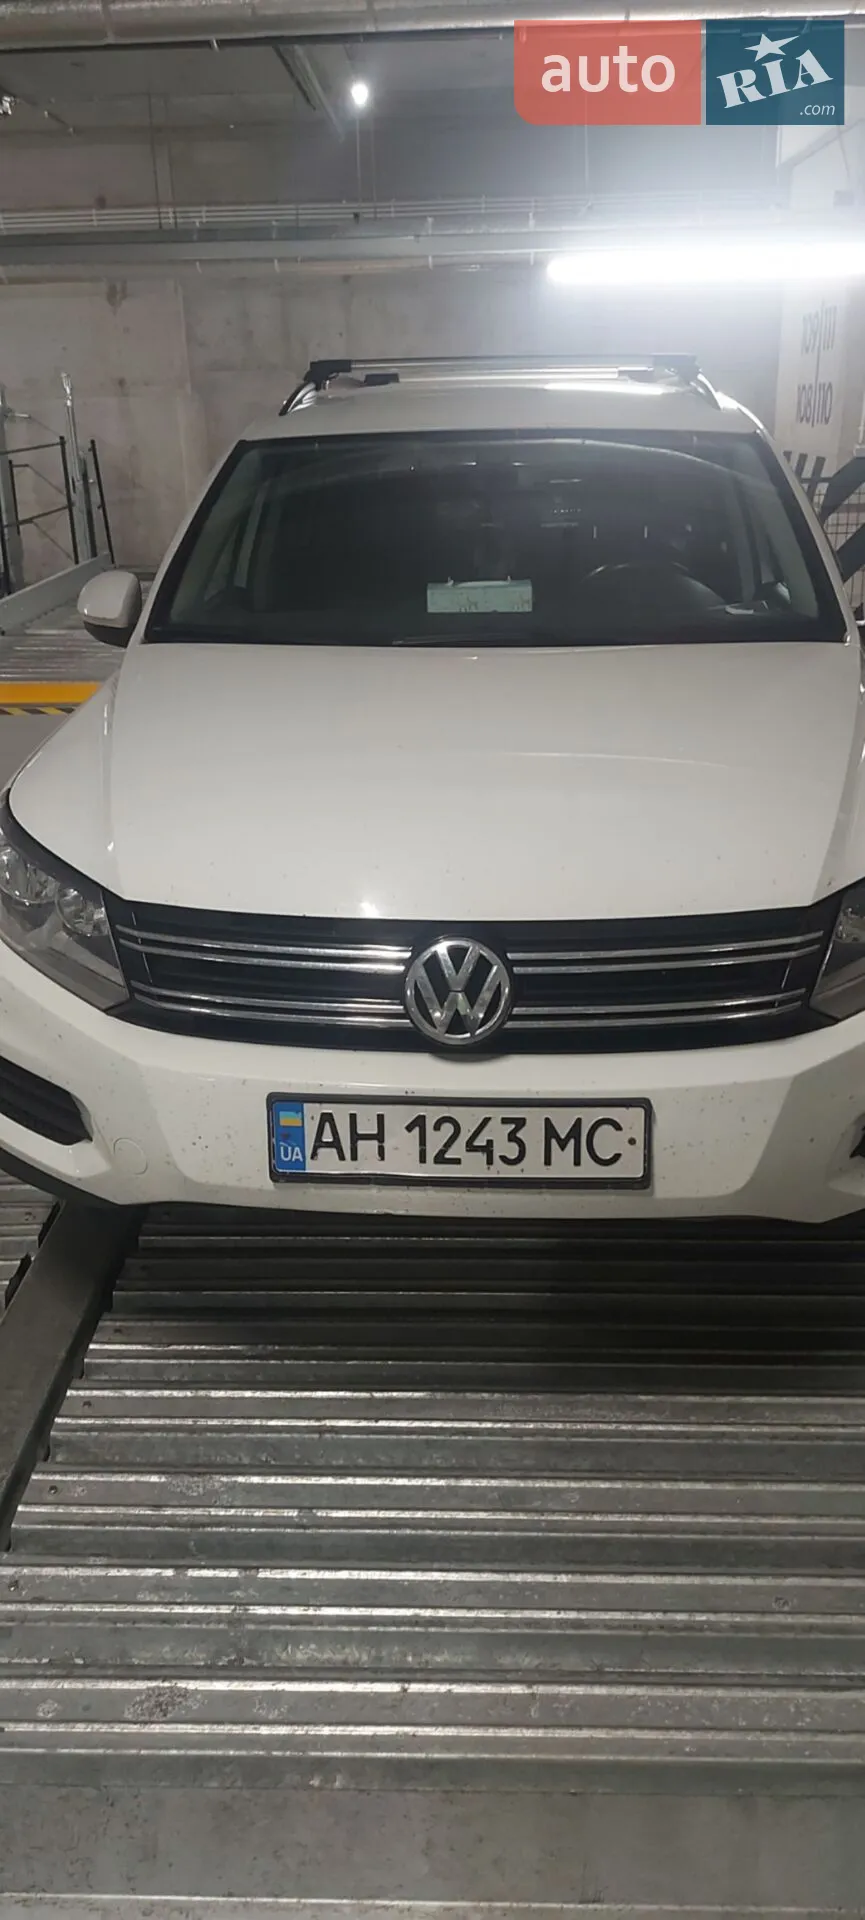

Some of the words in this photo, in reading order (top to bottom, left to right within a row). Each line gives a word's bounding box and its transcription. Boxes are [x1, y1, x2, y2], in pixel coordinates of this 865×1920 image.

[280, 1146, 303, 1162] UA
[310, 1112, 385, 1162] AH
[405, 1114, 527, 1166] 1243
[544, 1117, 623, 1167] MC
